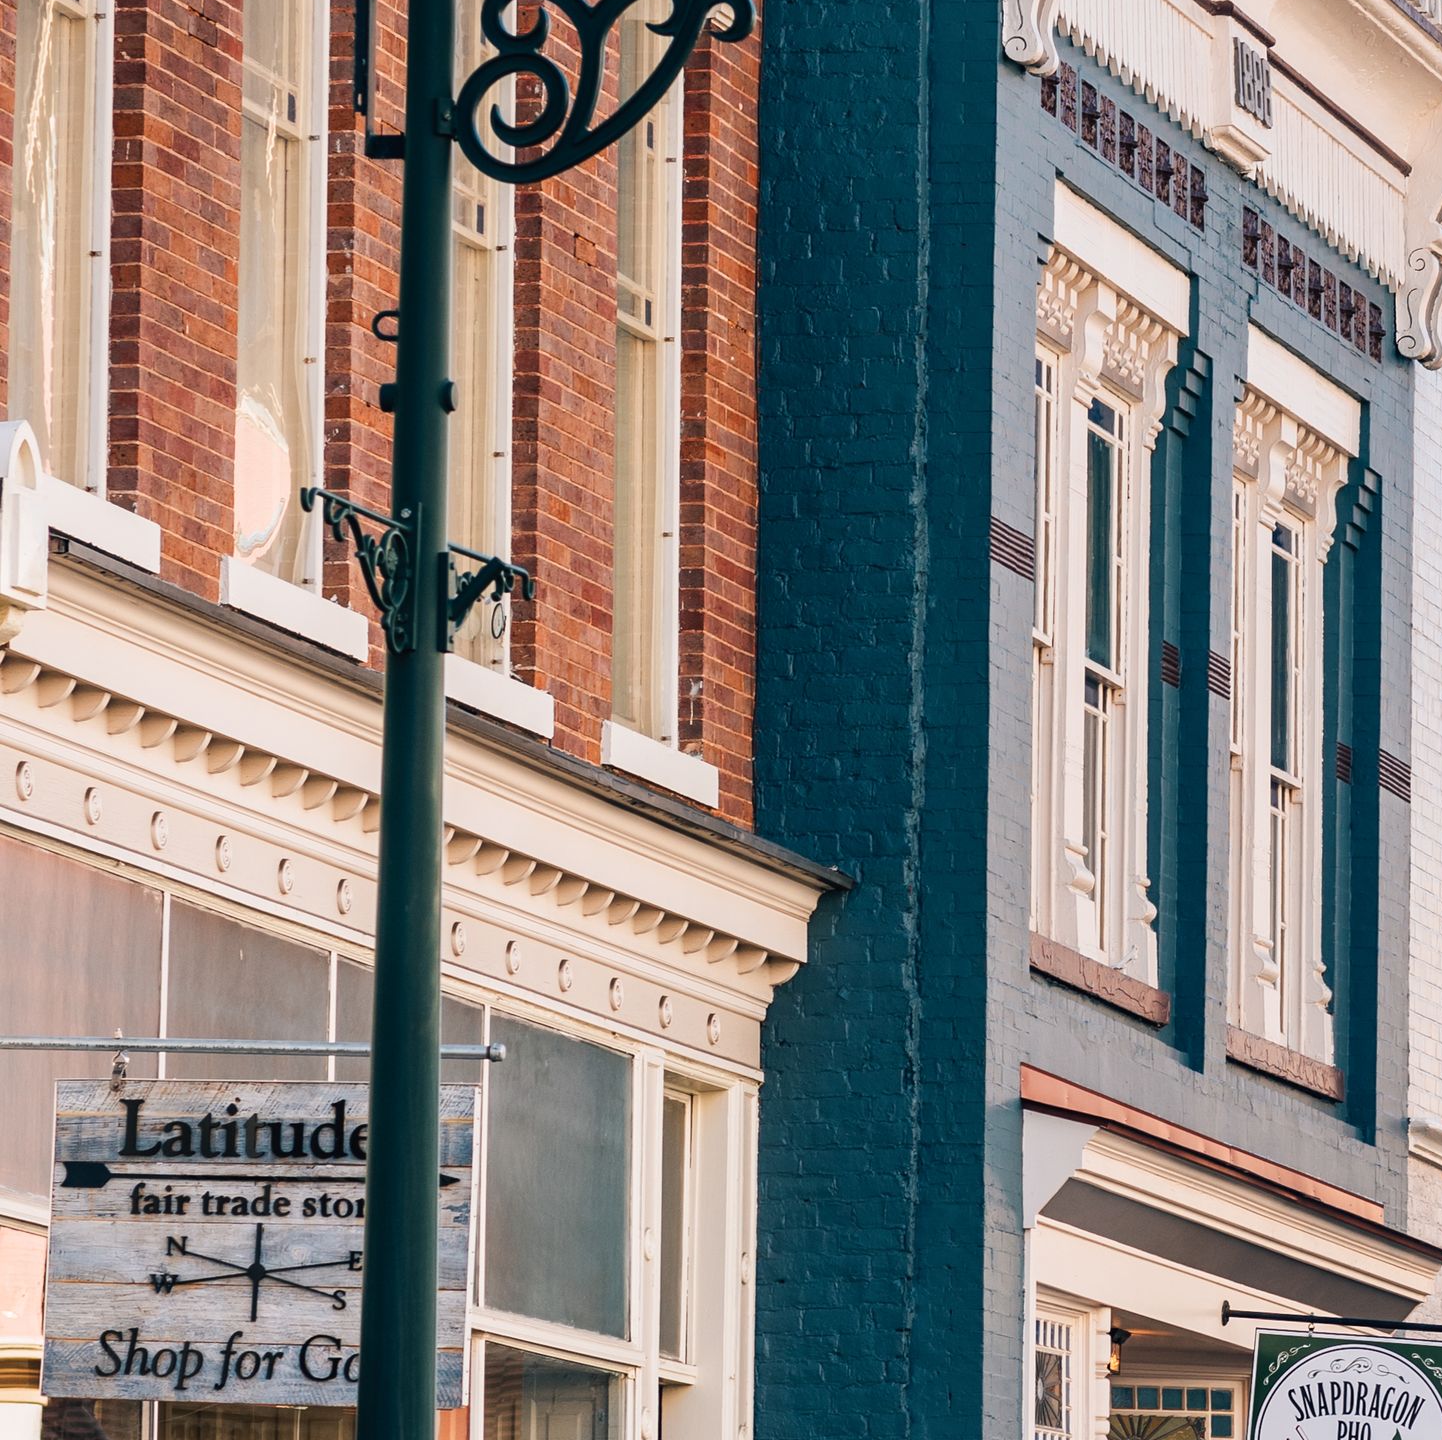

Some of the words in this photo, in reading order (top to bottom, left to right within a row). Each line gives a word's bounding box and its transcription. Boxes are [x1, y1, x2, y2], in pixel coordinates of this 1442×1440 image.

[1233, 37, 1273, 129] 1888
[118, 1098, 369, 1160] Latitude
[130, 1182, 191, 1216] fair
[201, 1184, 291, 1217] trade
[302, 1192, 365, 1218] stor
[166, 1235, 189, 1257] N
[149, 1273, 179, 1294] W
[331, 1289, 347, 1311] S
[94, 1327, 204, 1391] Shop
[213, 1330, 284, 1391] for
[299, 1333, 360, 1383] Go
[1287, 1380, 1427, 1431] SNAPDRAGON
